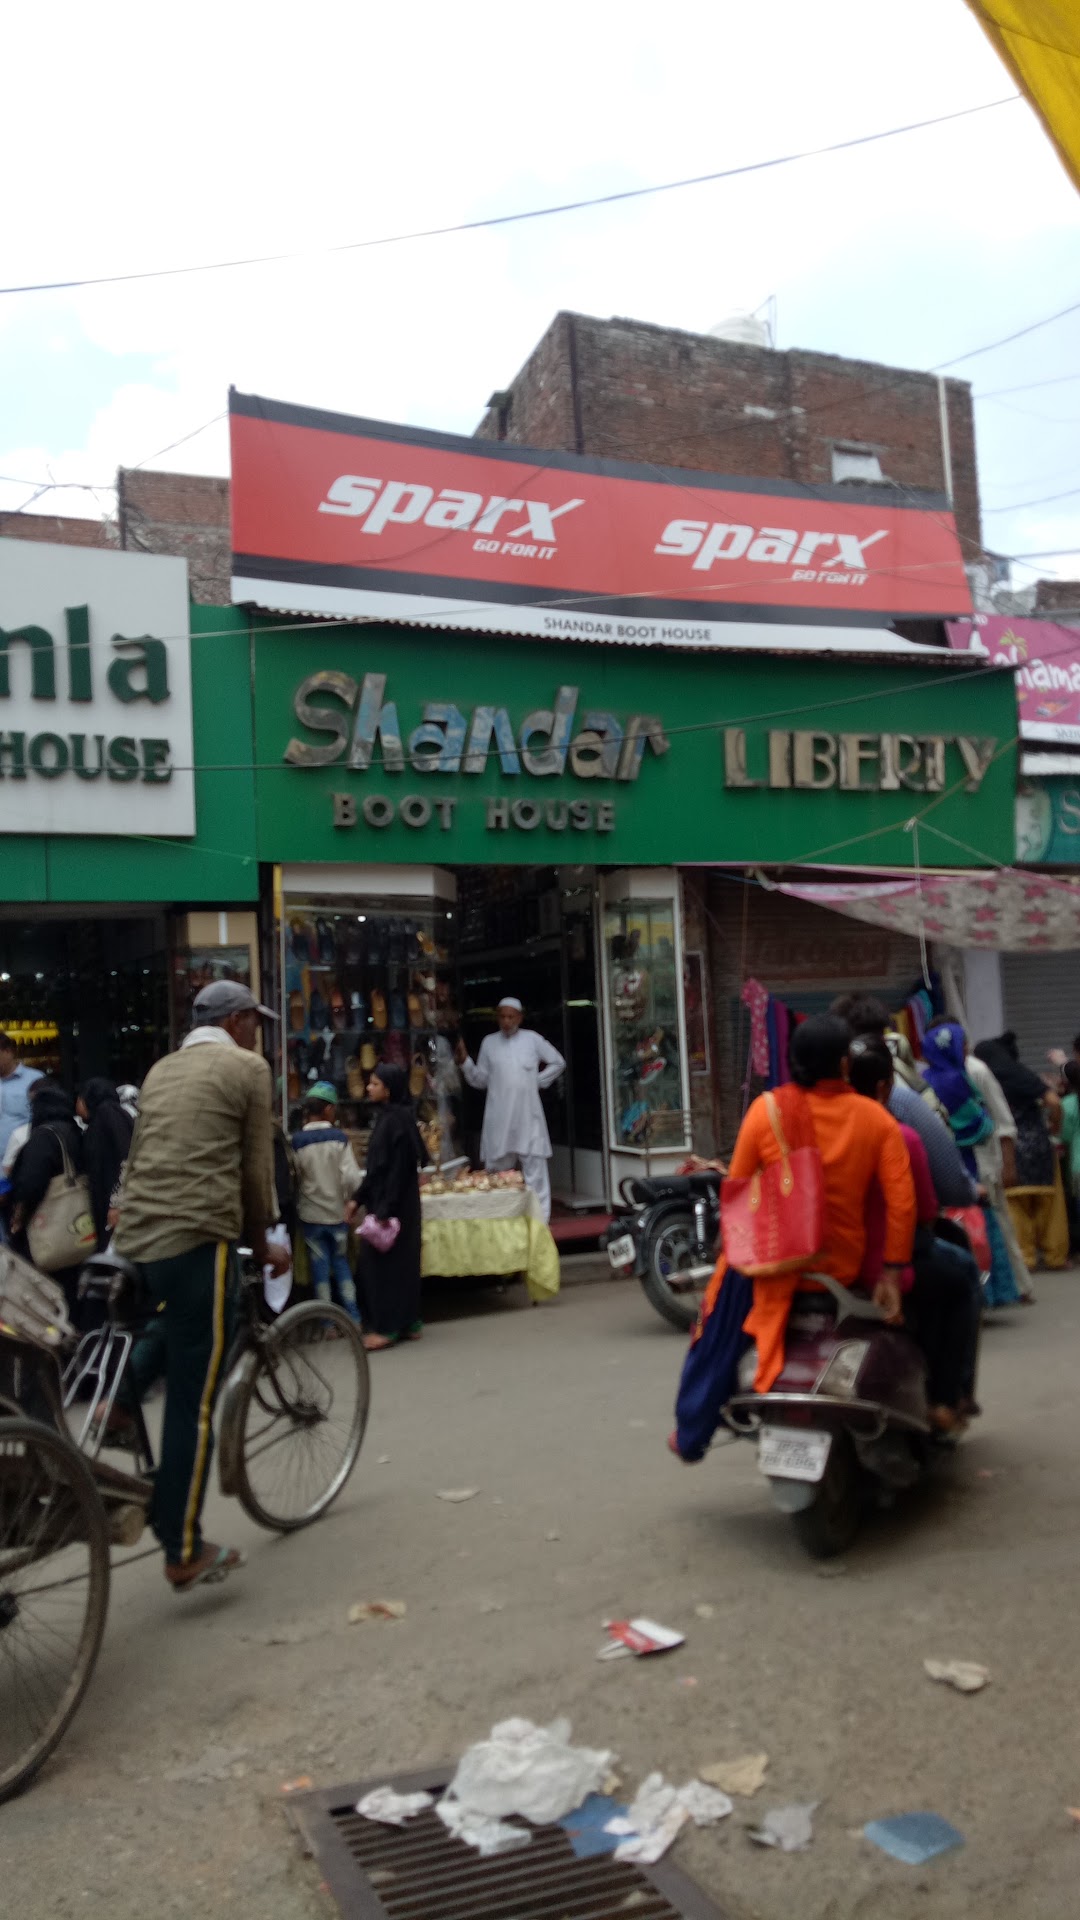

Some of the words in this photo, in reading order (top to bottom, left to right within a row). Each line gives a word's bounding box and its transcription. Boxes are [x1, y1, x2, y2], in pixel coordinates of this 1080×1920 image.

[318, 475, 585, 542] sparx
[472, 538, 500, 553] GO
[500, 542, 538, 558] FOR
[538, 546, 558, 560] IT
[654, 519, 889, 570] sparx
[544, 617, 612, 635] SHANDAR
[617, 625, 656, 639] BOOT
[662, 627, 712, 641] HOUSE
[284, 670, 670, 781] Shandar
[0, 731, 173, 785] HOUSE
[724, 728, 998, 792] LIBERTY
[333, 792, 457, 830] BOOT
[487, 798, 615, 832] HOUSE
